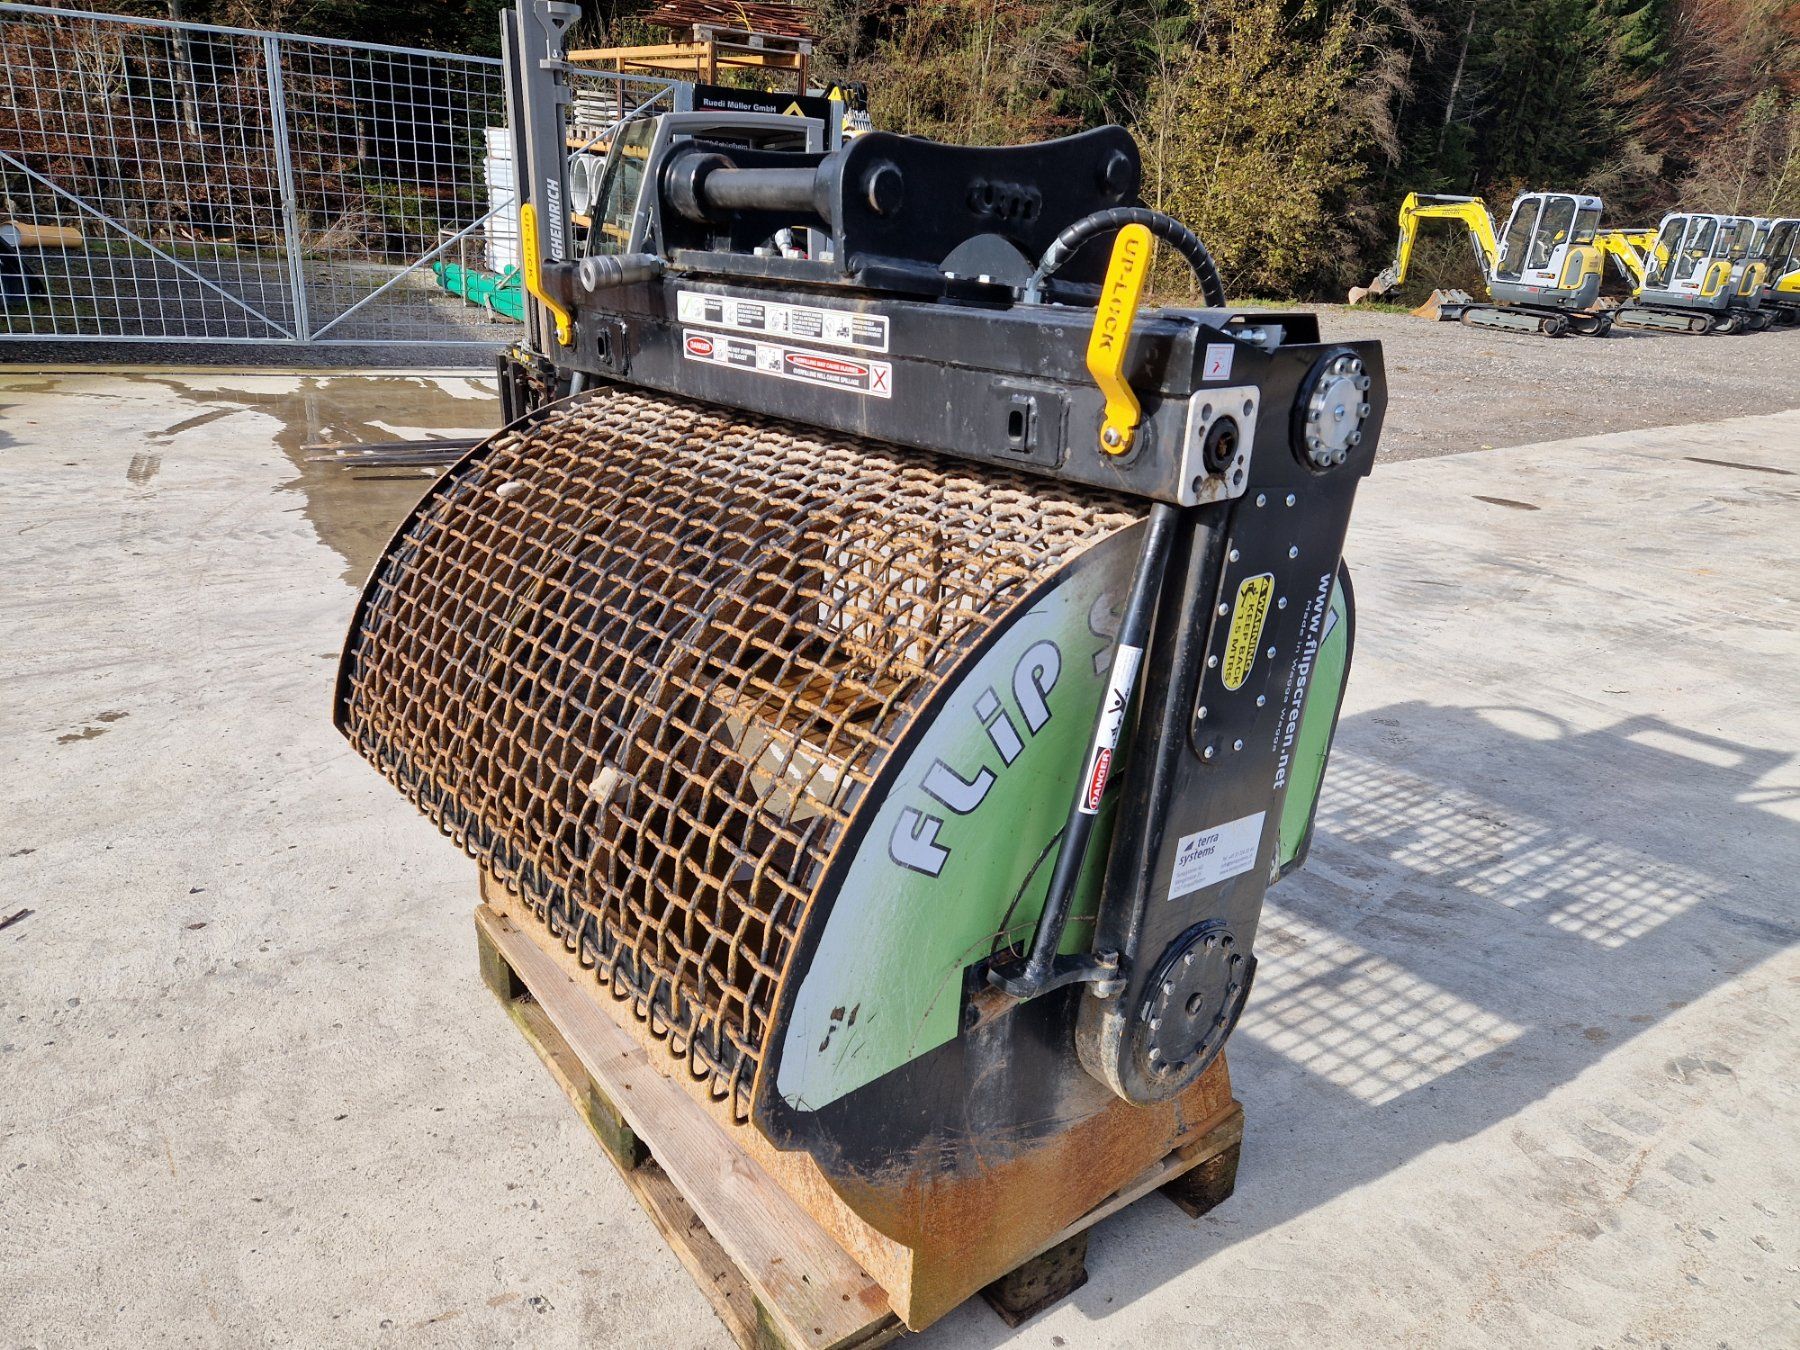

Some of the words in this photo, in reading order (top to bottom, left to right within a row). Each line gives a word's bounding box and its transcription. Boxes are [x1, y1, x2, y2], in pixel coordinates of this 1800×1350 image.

[703, 98, 726, 108] Ruedi
[727, 100, 752, 111] Müller
[753, 103, 777, 113] GmbH
[547, 178, 564, 262] GHEINRICH
[1099, 238, 1139, 352] UP-LOCK
[1243, 603, 1255, 641] KEEP
[1245, 595, 1266, 672] WARNING
[1299, 599, 1311, 635] Made
[1225, 638, 1239, 681] MTRS
[1232, 645, 1246, 686] BACK
[1272, 572, 1331, 790] www.flipscreen.net
[1283, 658, 1298, 703] Wagga
[1272, 708, 1285, 752] Wagga
[1091, 752, 1111, 806] DANGER
[1178, 845, 1216, 867] systems
[1197, 833, 1220, 848] terra
